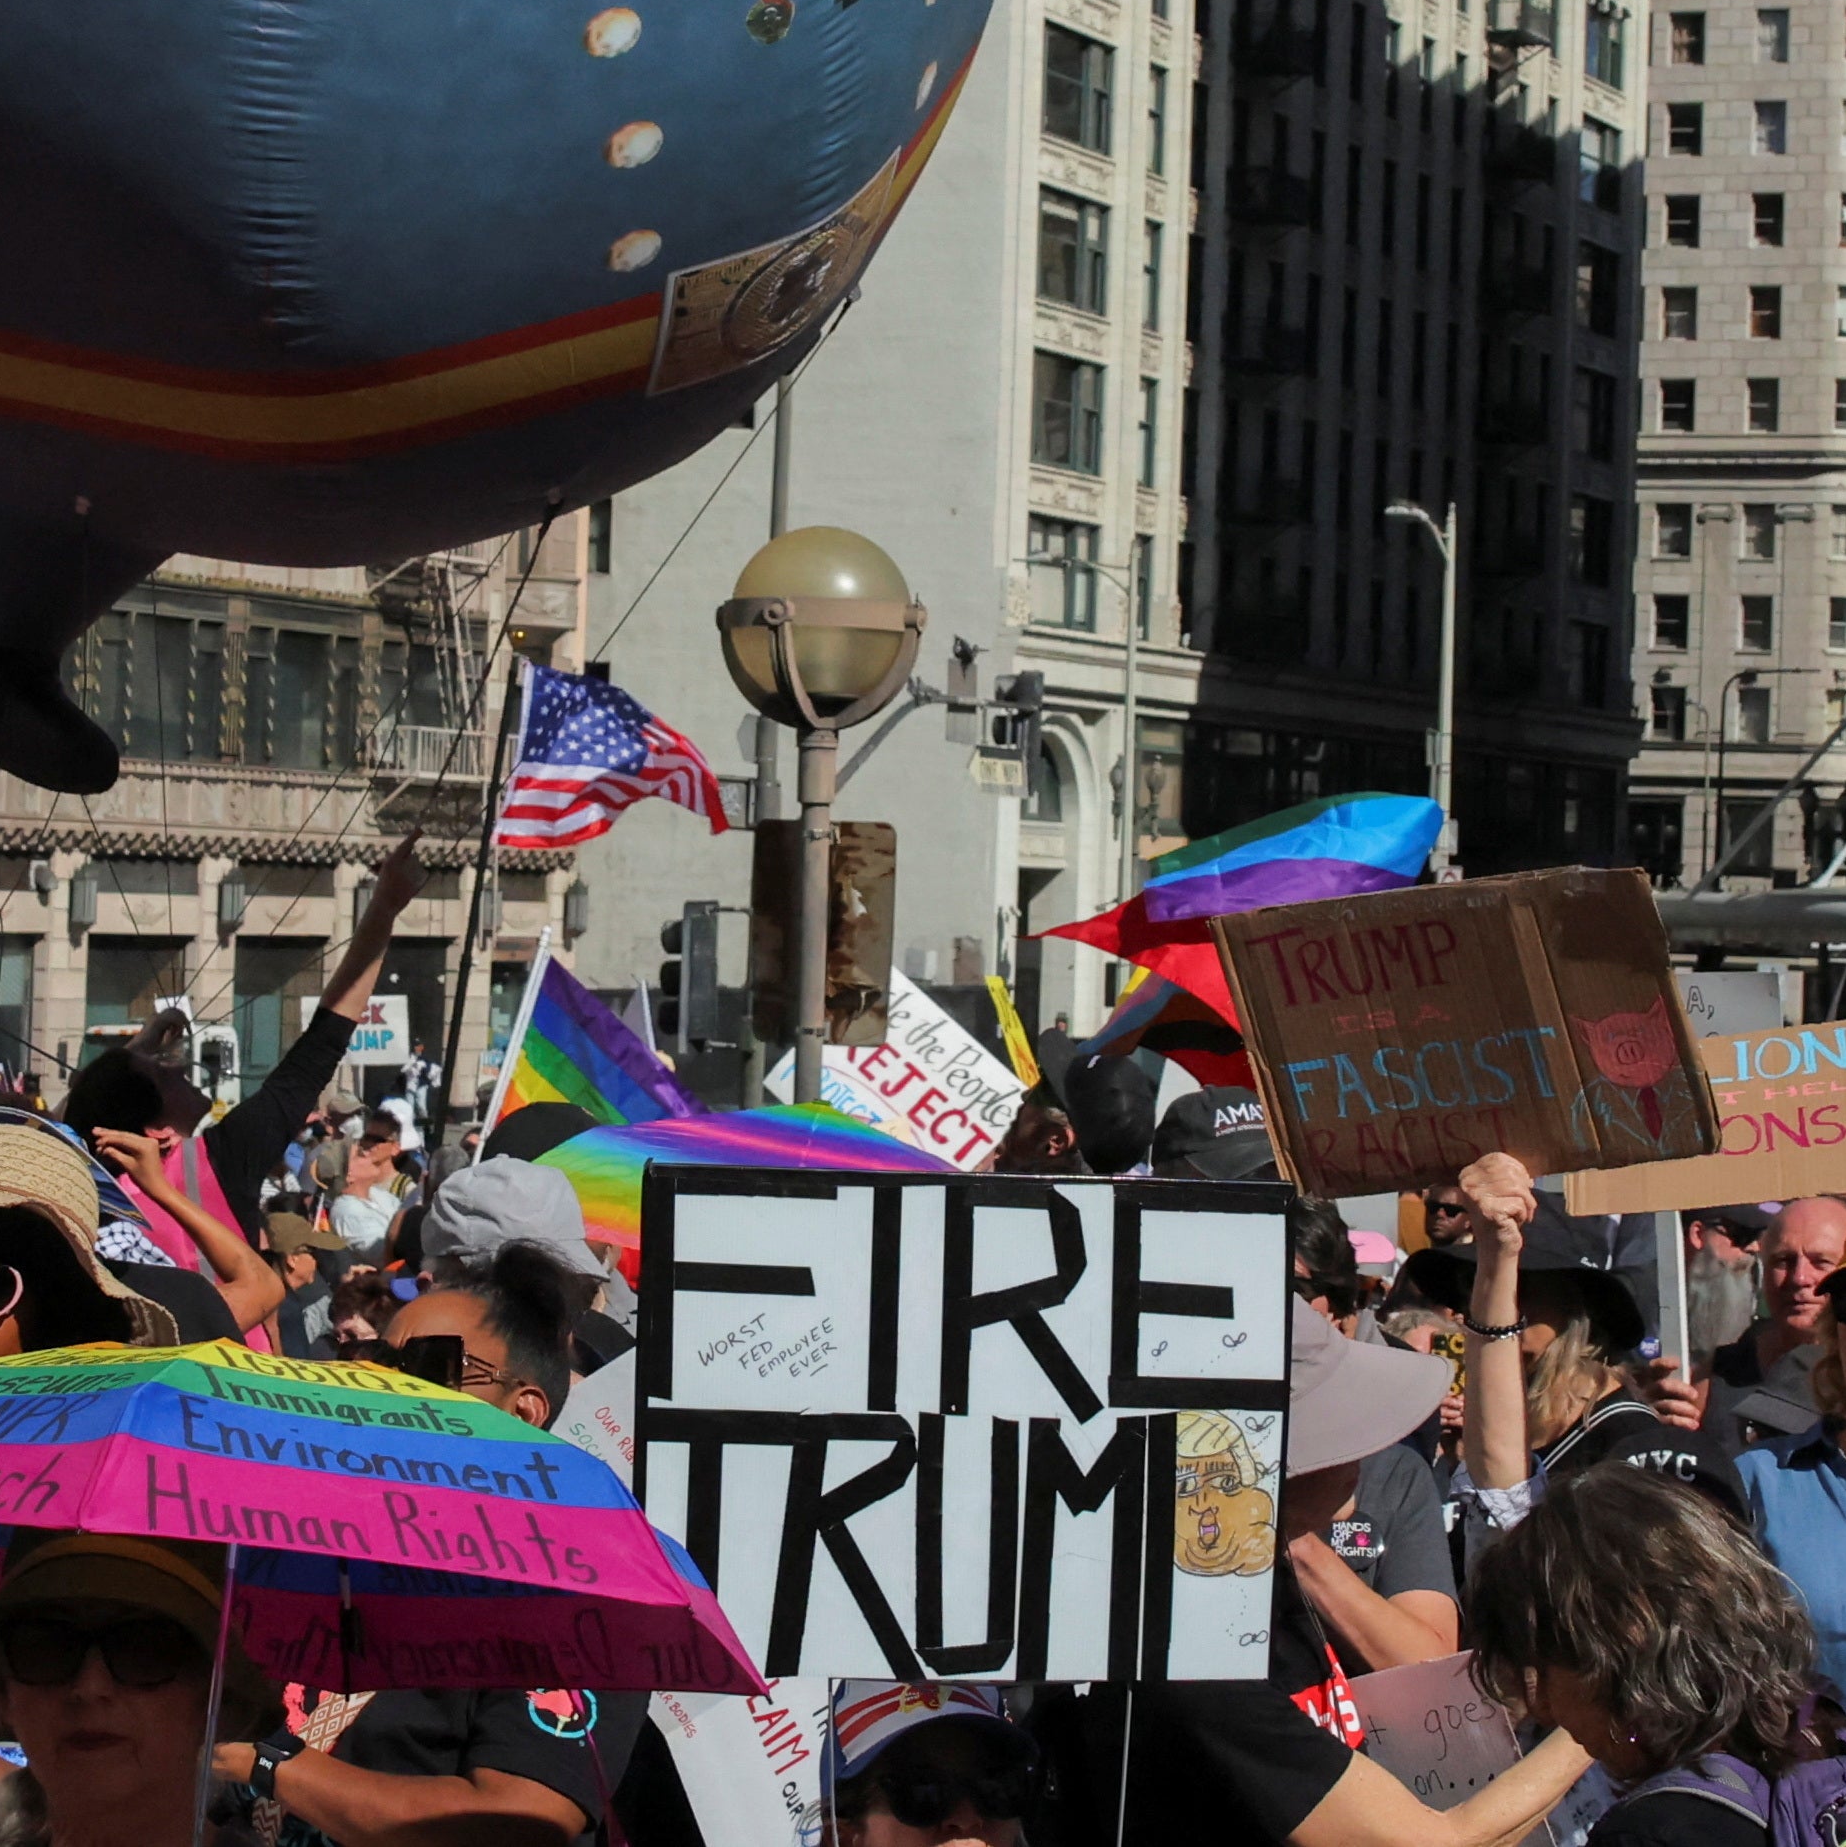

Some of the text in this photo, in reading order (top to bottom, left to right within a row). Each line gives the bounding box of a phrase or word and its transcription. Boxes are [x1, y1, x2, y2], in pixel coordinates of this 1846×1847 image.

[1246, 920, 1456, 1007] TRUMP
[847, 1043, 994, 1164] EJECT
[906, 1019, 949, 1064] the
[935, 1042, 1022, 1128] People
[1280, 1026, 1557, 1124] FASCIST
[1302, 1106, 1517, 1191] RACIST
[643, 1167, 1290, 1424] FIRE
[697, 1313, 768, 1367] WORST
[737, 1340, 774, 1370] FED
[757, 1317, 835, 1379] EMPLOYEE
[788, 1340, 839, 1378] EVER
[209, 1362, 474, 1438] Immigrants
[594, 1406, 621, 1438] OUR
[177, 1394, 561, 1500] Environment
[146, 1454, 600, 1586] Human Rights
[1332, 1521, 1372, 1533] HANDS
[1335, 1546, 1376, 1558] RIGHTS!
[668, 1702, 698, 1739] BODIES
[1424, 1696, 1499, 1762] goes
